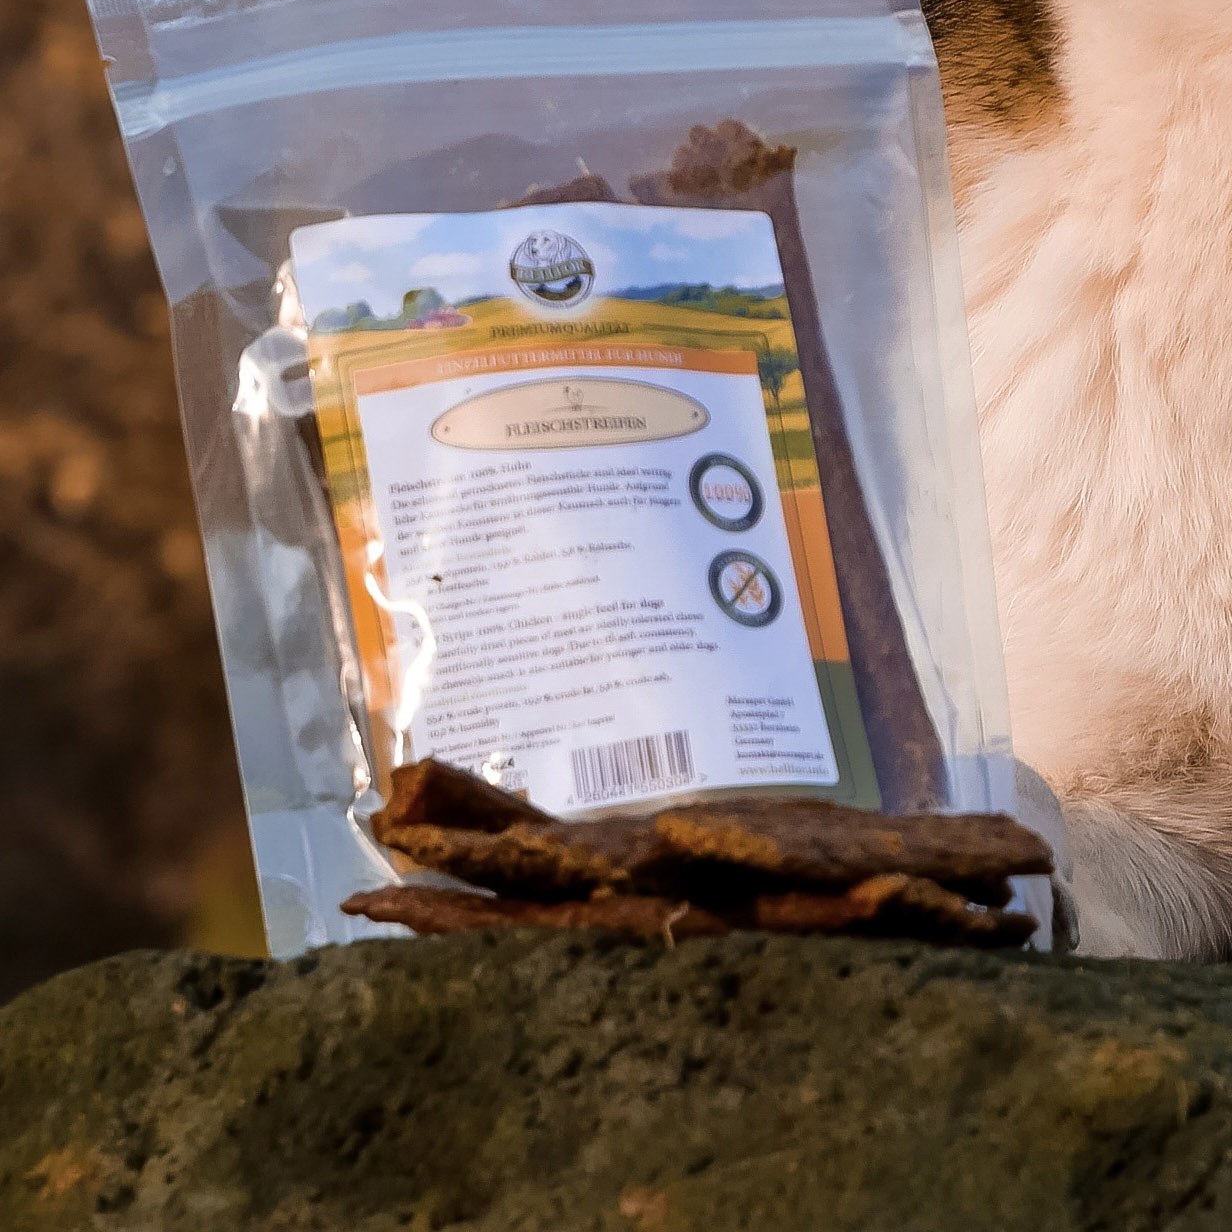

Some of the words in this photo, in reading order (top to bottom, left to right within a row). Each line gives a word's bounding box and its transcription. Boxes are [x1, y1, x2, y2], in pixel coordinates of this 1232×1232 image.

[504, 416, 647, 439] FLEISCHSTREIFEN
[703, 482, 751, 505] 100%
[507, 614, 553, 631] Chicken
